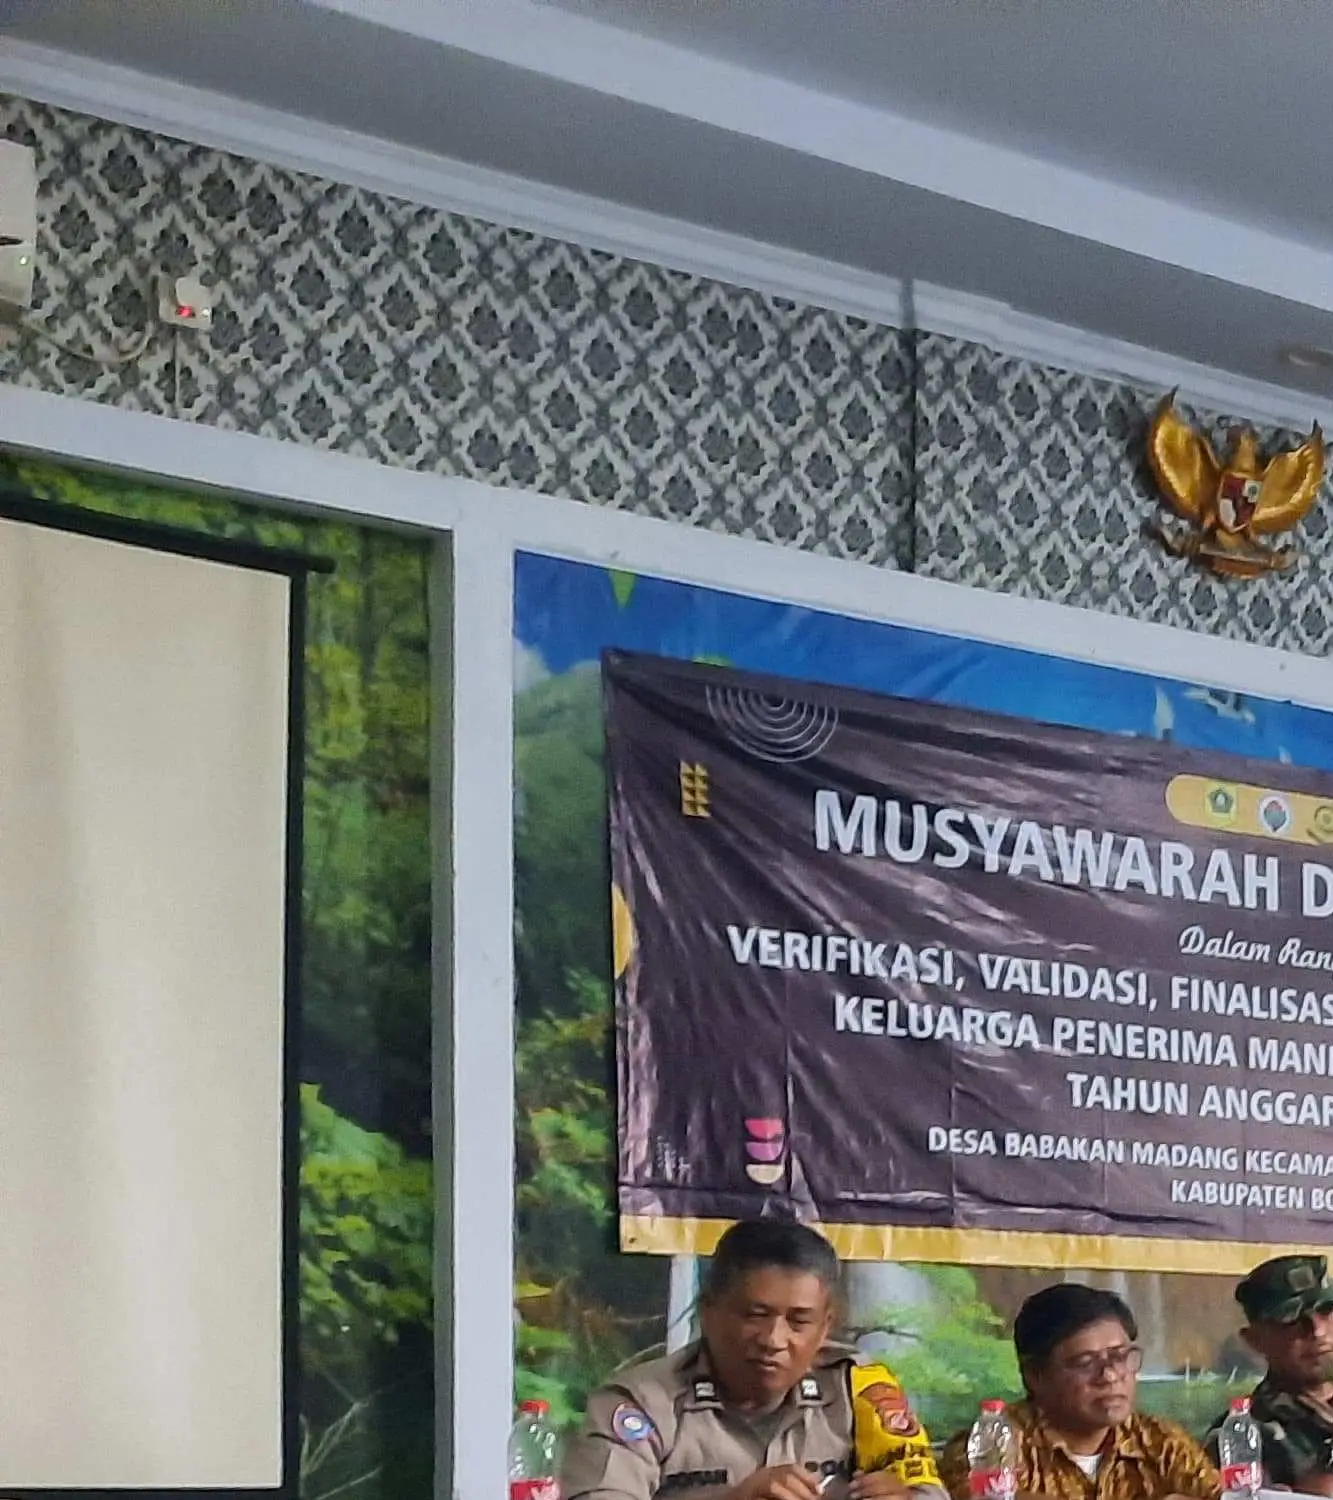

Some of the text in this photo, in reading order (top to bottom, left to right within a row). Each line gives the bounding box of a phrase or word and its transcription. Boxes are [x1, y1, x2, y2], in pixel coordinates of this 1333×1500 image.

[813, 788, 1280, 912] MUSYAWARAH
[727, 924, 967, 992] VERIFIKASI,
[979, 953, 1158, 1012] VALIDASI,
[1178, 925, 1271, 965] Dalam
[834, 994, 1040, 1050] KELUARGA
[1052, 1014, 1238, 1069] PENERIMA
[1066, 1073, 1189, 1117] TAHUN
[928, 1126, 996, 1158] DESA
[1004, 1131, 1125, 1165] BABAKAN
[1131, 1139, 1238, 1172] MADANG
[1170, 1178, 1304, 1210] KABUPATEN
